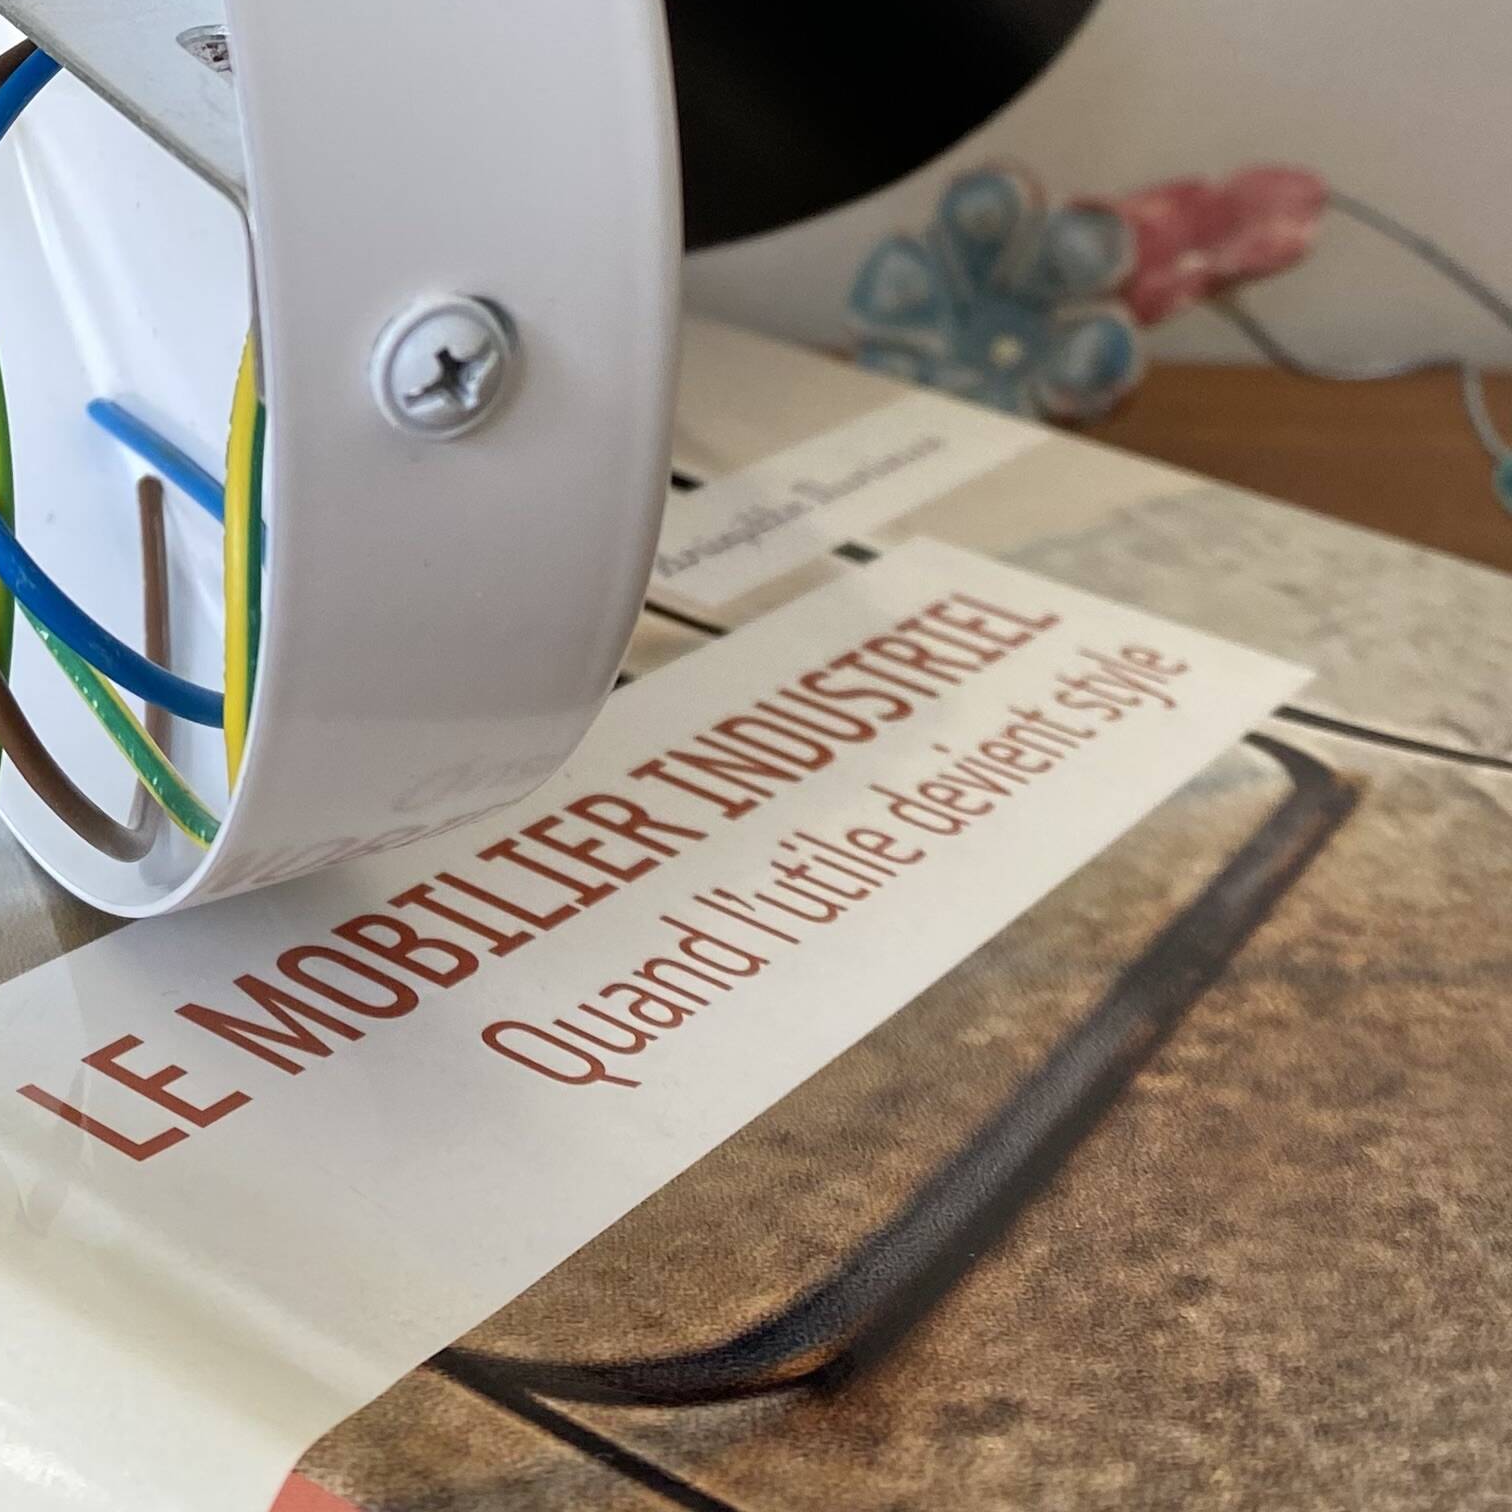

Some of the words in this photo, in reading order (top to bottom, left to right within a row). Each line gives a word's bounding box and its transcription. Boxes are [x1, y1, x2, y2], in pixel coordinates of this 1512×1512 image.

[16, 1033, 252, 1163] LE
[175, 793, 710, 1076] MOBILIER
[629, 592, 1062, 820] INDUSTRIEL
[480, 914, 771, 1089] Quand
[869, 703, 1098, 837] devient
[1054, 645, 1192, 722] style
